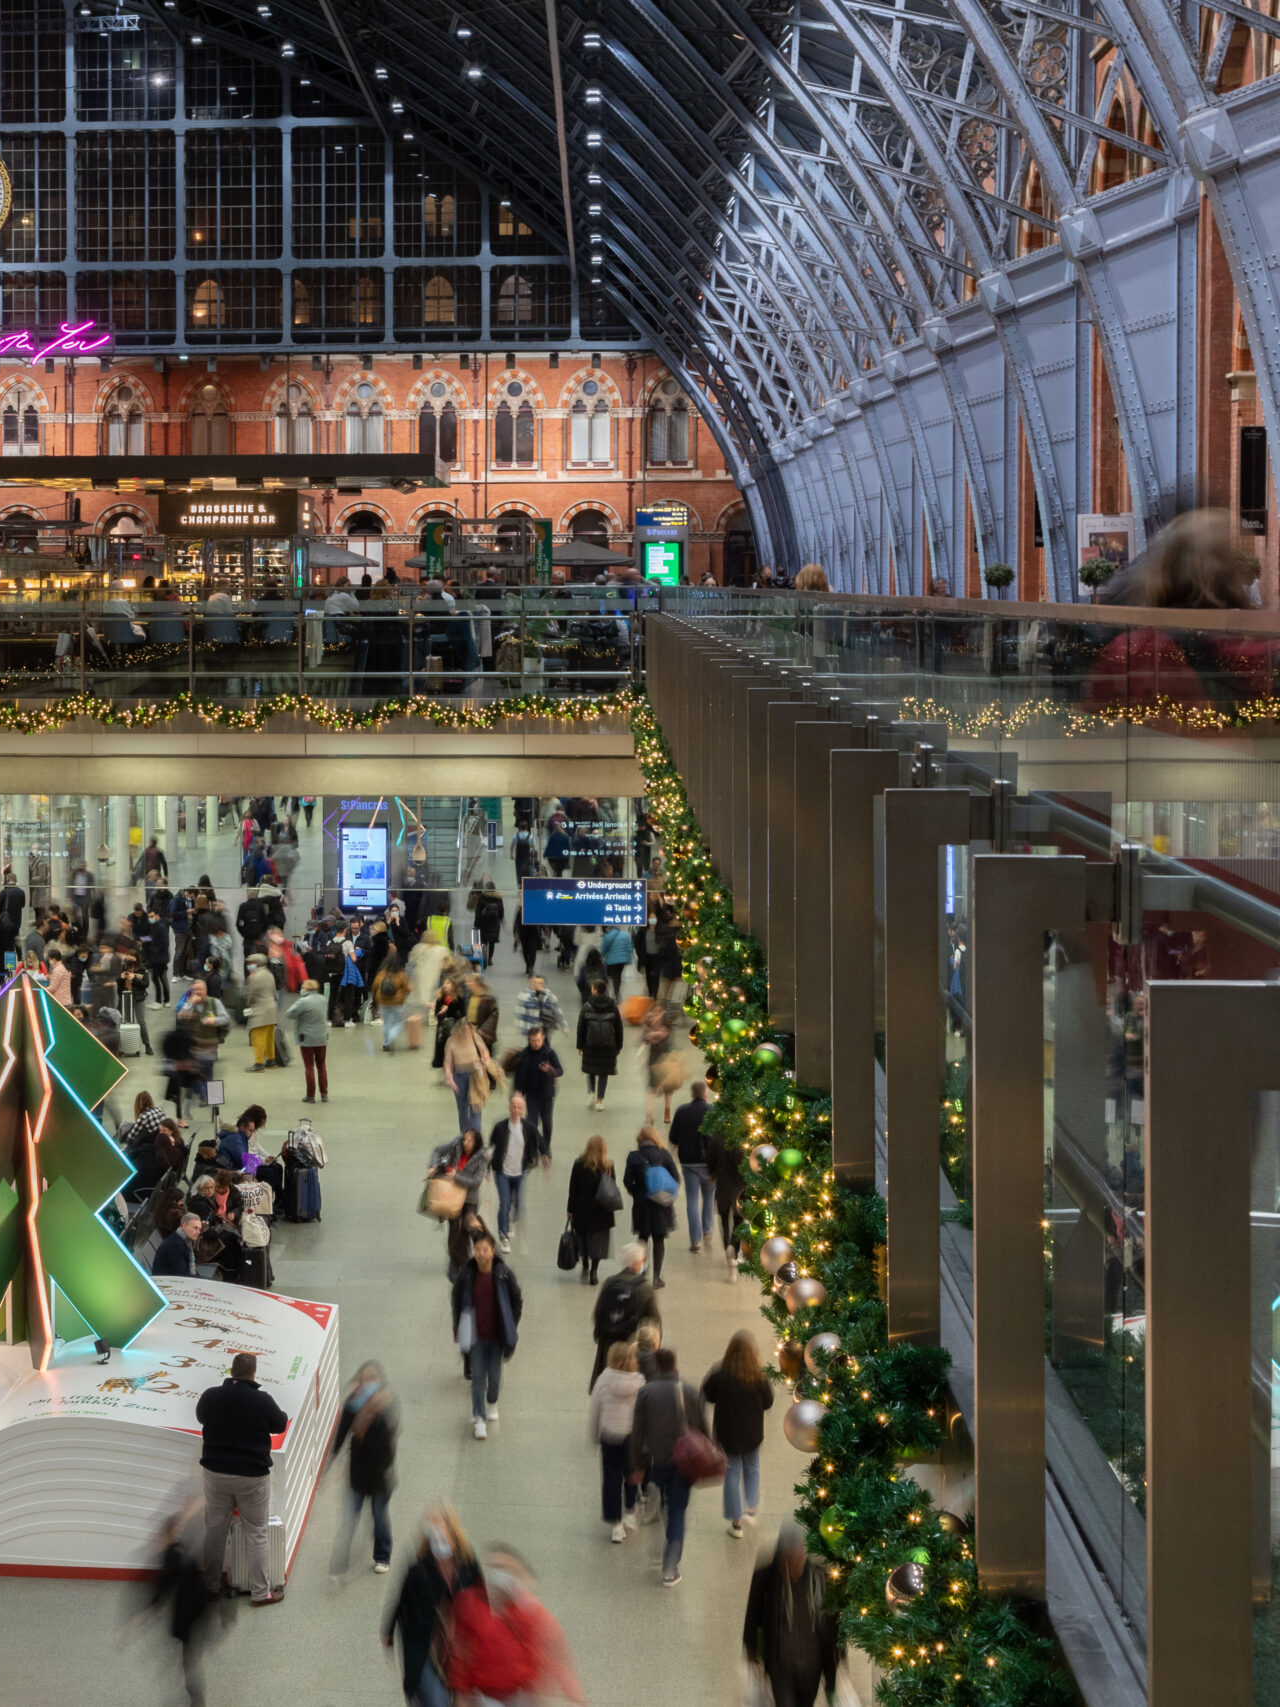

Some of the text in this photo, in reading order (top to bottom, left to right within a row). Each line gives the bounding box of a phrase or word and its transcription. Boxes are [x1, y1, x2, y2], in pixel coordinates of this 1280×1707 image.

[190, 504, 266, 514] BRASSERIE &
[181, 515, 276, 524] CHAMPAGNE BAR
[587, 881, 632, 890] Underground
[575, 891, 604, 900] Arrivées
[604, 892, 632, 900] Arrivals
[191, 1339, 224, 1349] 4
[160, 1355, 197, 1368] 3
